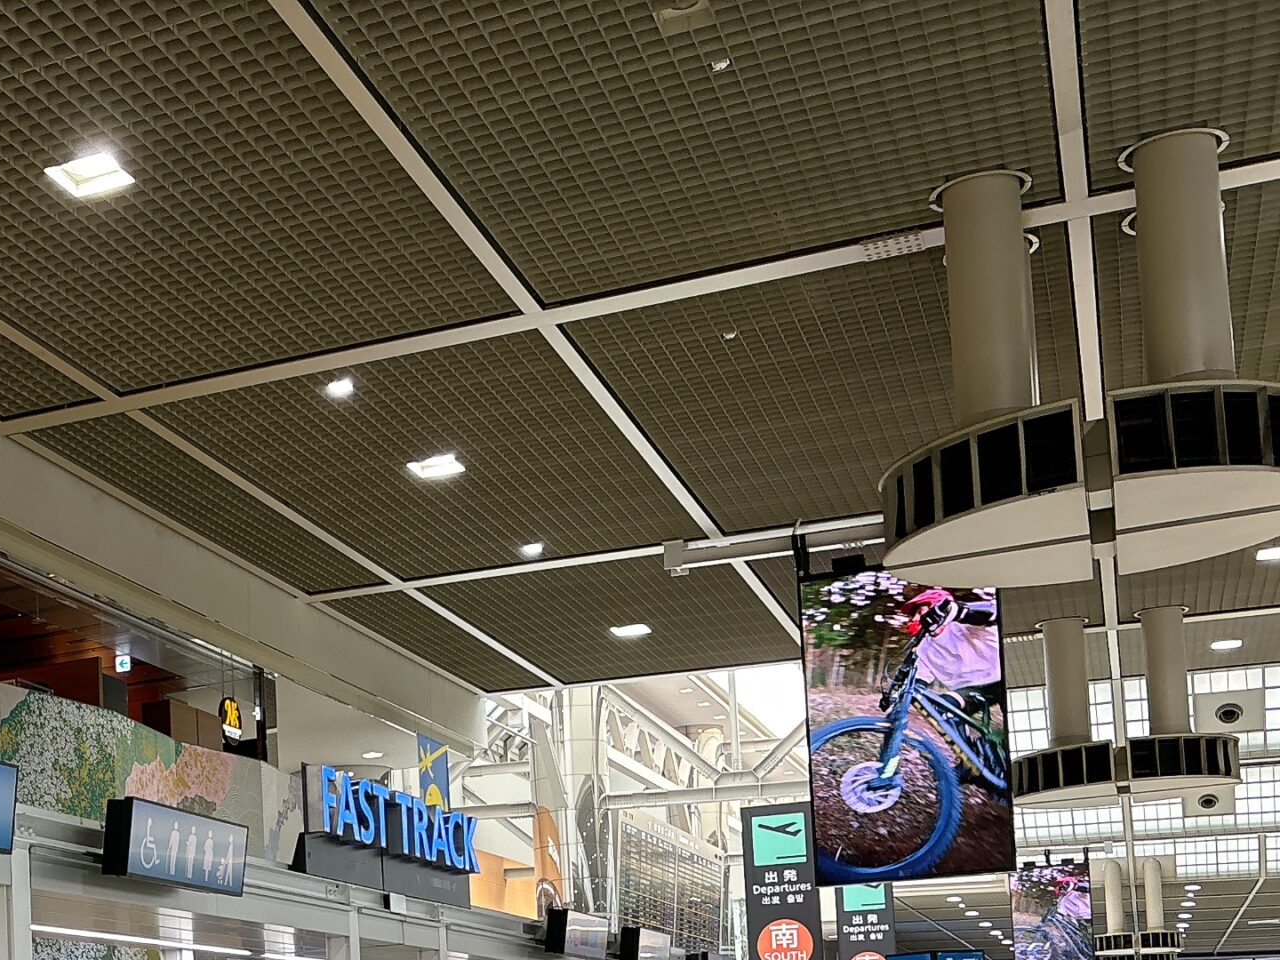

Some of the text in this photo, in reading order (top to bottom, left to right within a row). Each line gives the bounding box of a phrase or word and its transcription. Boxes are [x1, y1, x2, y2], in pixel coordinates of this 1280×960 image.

[321, 764, 480, 874] FAST TRACK
[765, 869, 798, 884] 出発
[752, 883, 812, 895] Departures
[768, 923, 799, 949] 南
[842, 924, 889, 934] Departures
